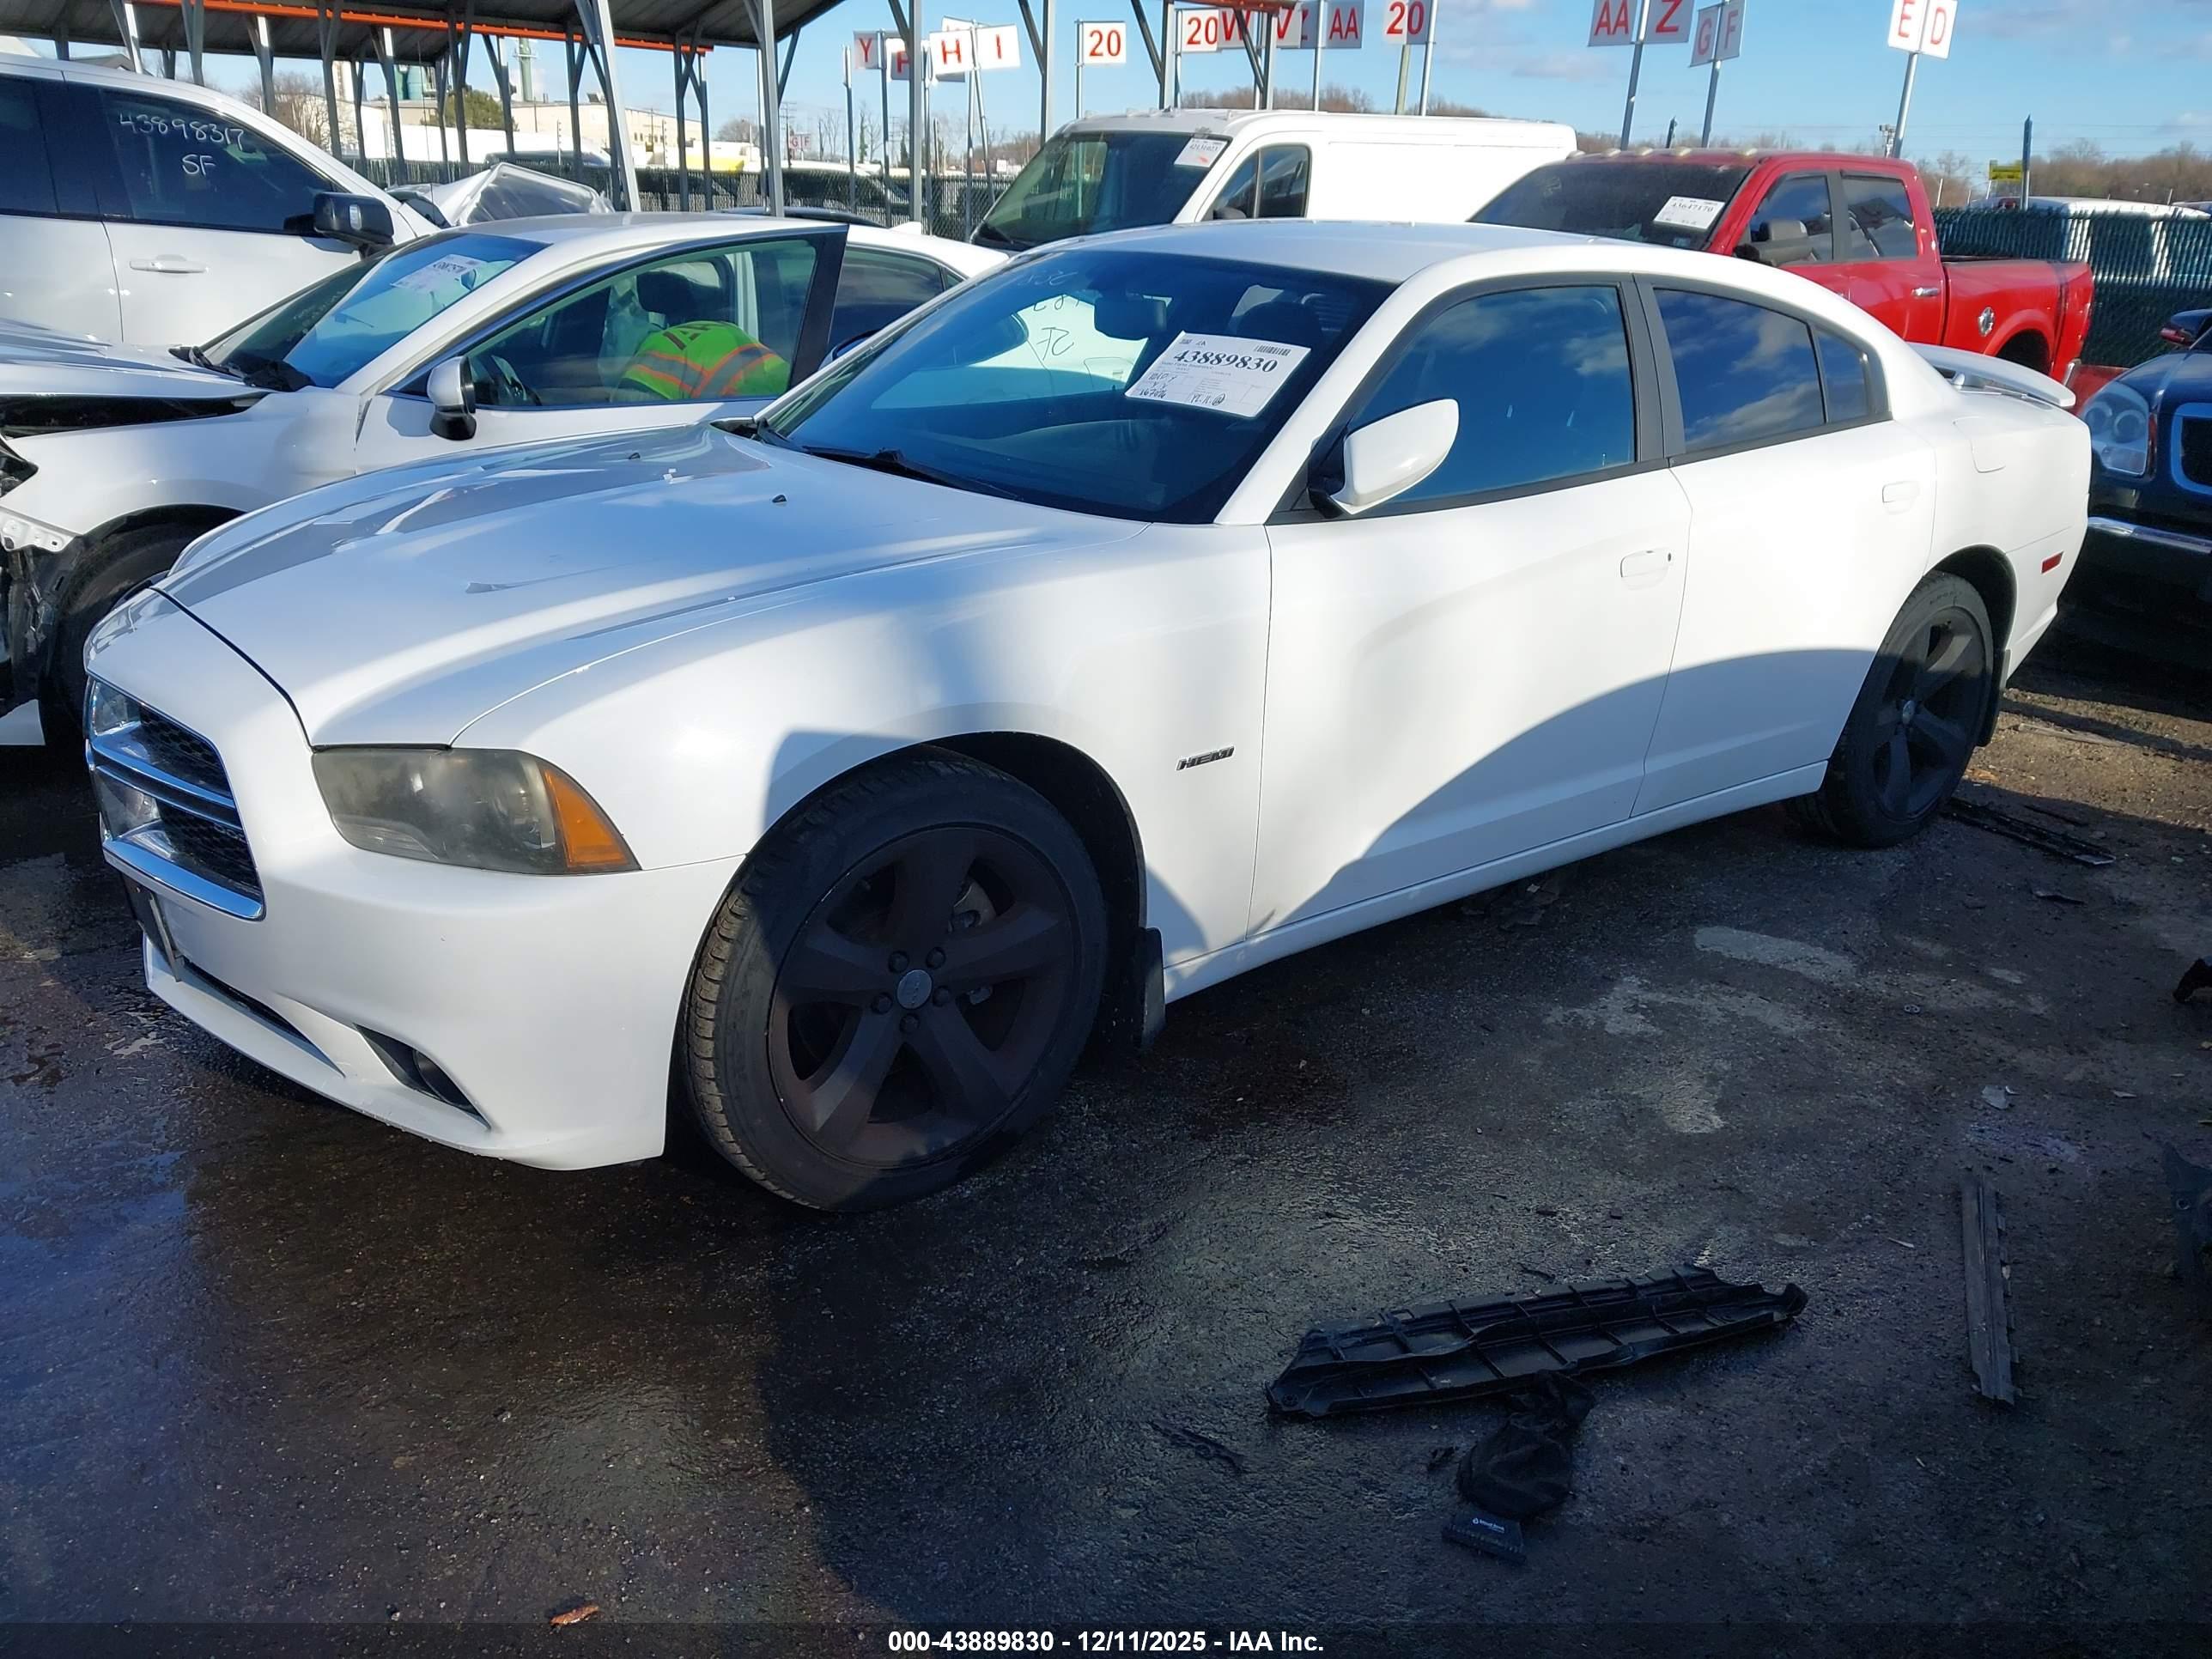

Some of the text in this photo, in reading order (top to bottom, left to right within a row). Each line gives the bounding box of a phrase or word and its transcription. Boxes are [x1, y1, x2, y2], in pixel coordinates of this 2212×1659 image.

[1186, 16, 1218, 46] 20
[1328, 8, 1358, 40] AA
[1386, 1, 1425, 35] 20
[1594, 0, 1629, 35] AA
[1656, 0, 1682, 33] Z
[1724, 9, 1739, 49] F
[1898, 0, 1916, 39] E
[1930, 7, 1947, 46] D
[859, 38, 872, 63] Y
[941, 39, 962, 64] H
[995, 33, 1002, 59] I
[1089, 29, 1121, 57] 20
[1698, 17, 1711, 56] G
[119, 112, 245, 151] 43898317
[181, 154, 216, 176] SF
[1174, 349, 1279, 374] 43889830
[1176, 745, 1235, 770] HEMI
